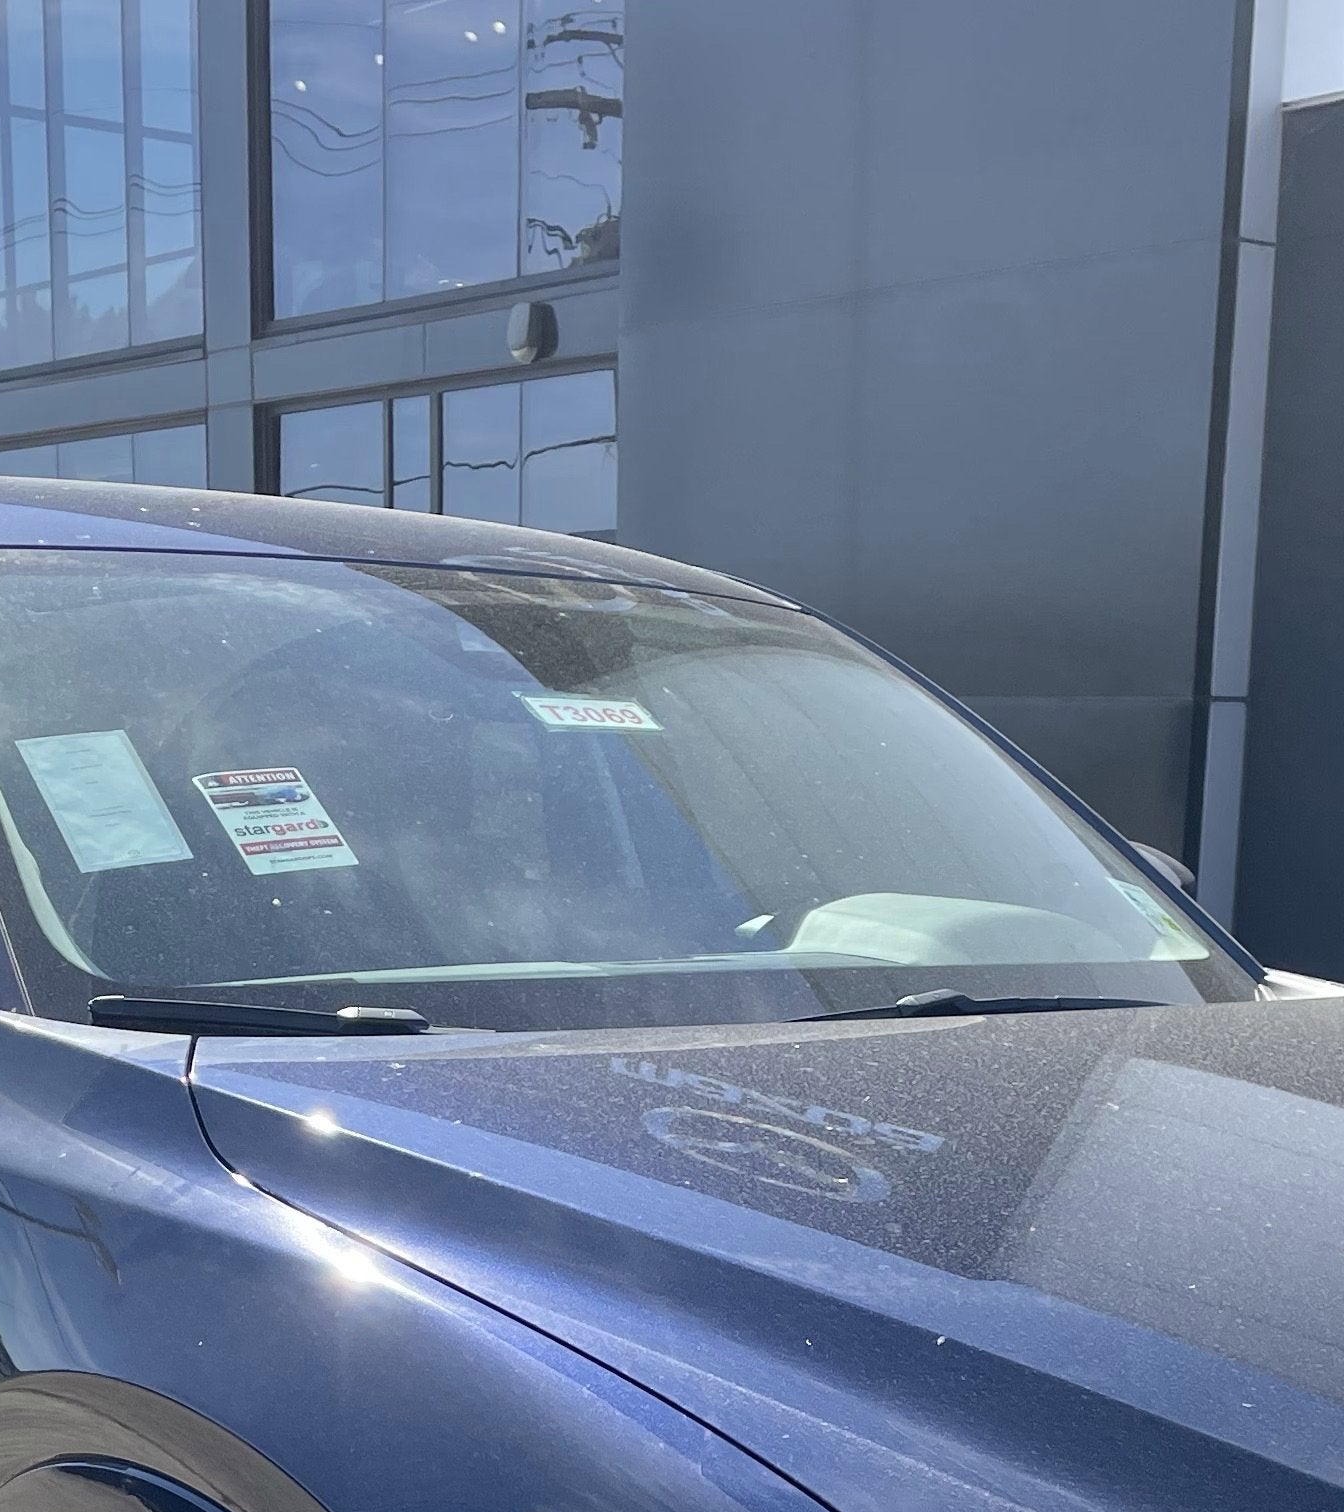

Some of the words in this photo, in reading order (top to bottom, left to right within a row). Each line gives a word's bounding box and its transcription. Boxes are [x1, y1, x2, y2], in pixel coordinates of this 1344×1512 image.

[538, 704, 643, 725] T3069
[228, 771, 296, 785] ATTENTION
[234, 819, 319, 837] stargard
[245, 844, 269, 853] THEFT
[269, 840, 309, 850] RECOVERY
[309, 837, 339, 847] SYSTEM
